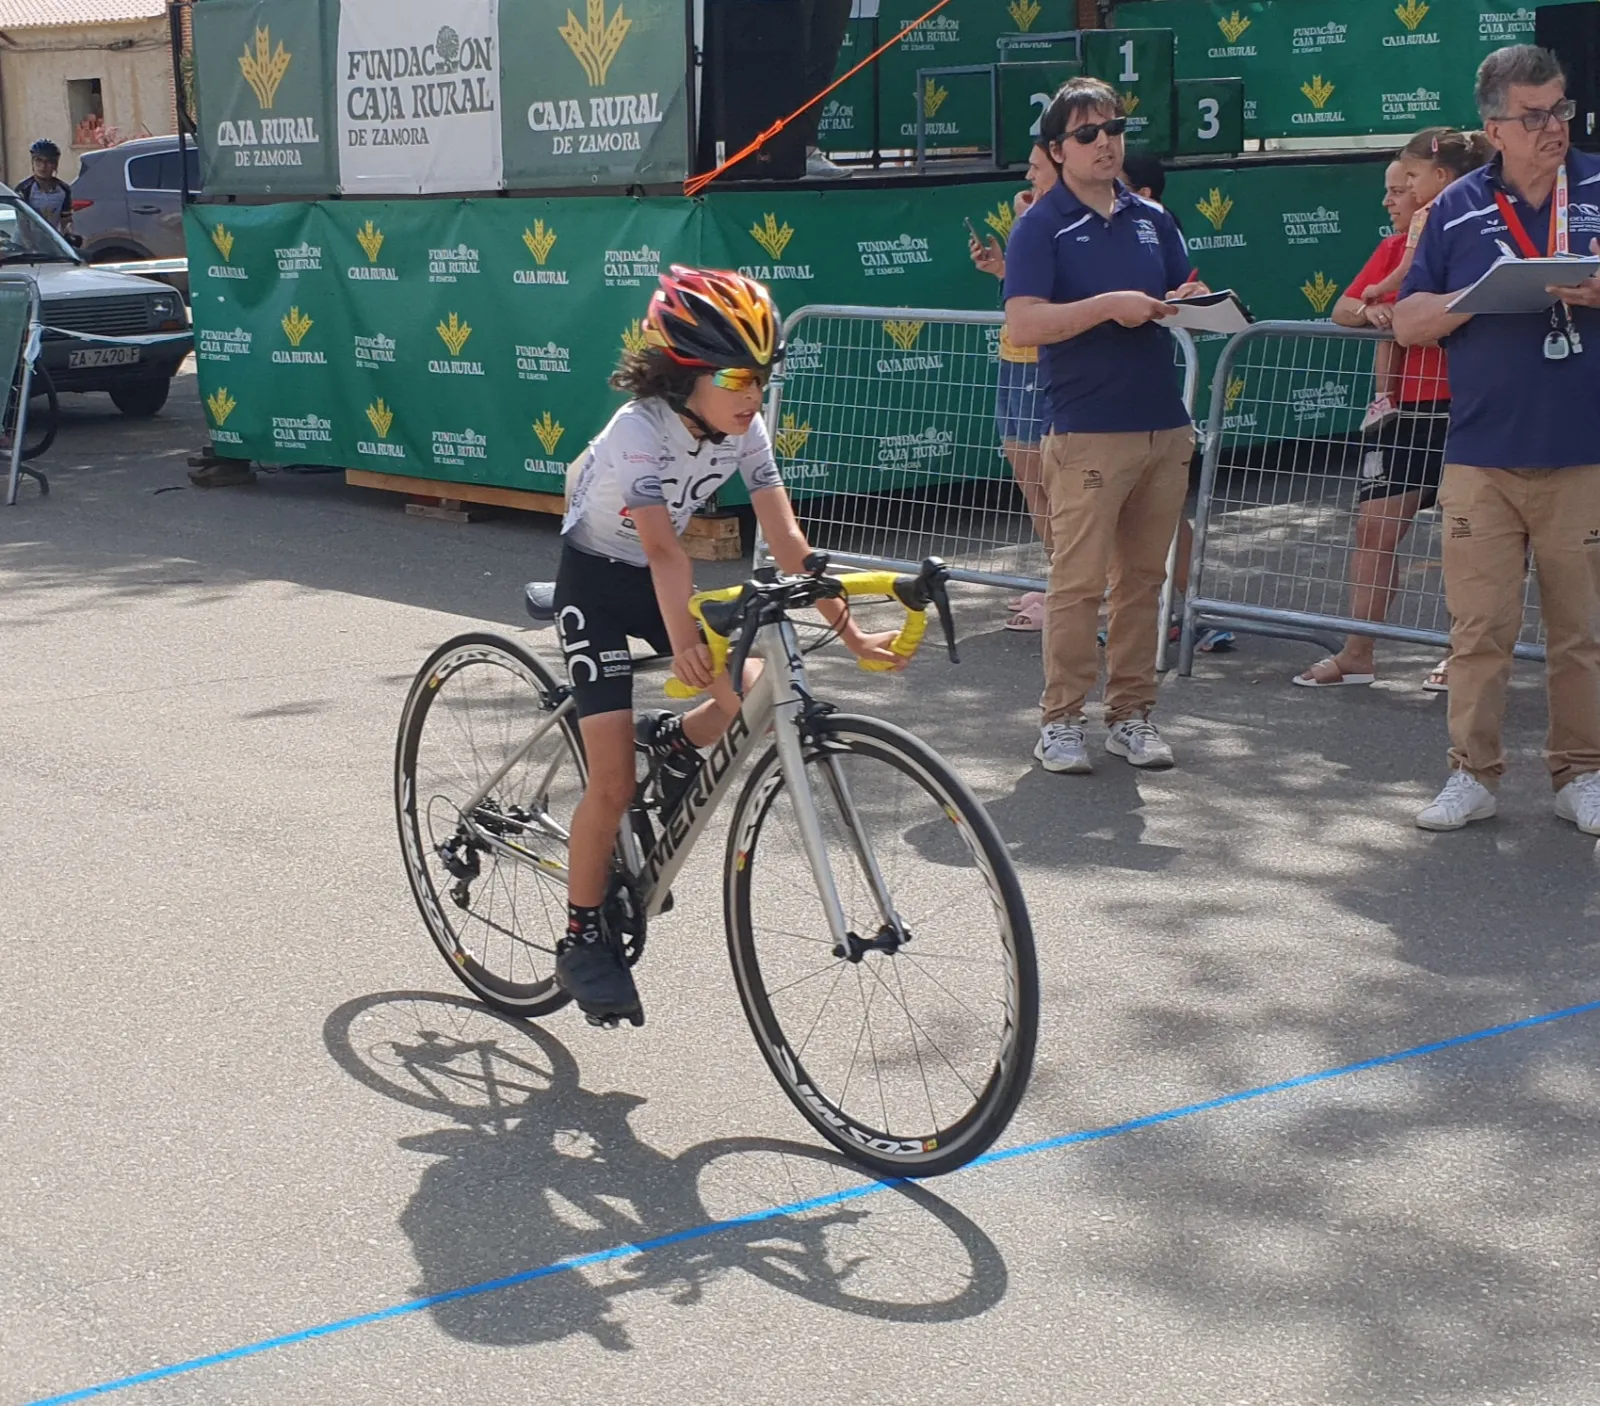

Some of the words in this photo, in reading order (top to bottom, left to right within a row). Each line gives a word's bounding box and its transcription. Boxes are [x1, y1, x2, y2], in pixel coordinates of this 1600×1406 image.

[1478, 22, 1504, 33] CAJA
[1507, 22, 1536, 32] RURA
[927, 32, 960, 42] RURAL
[1316, 34, 1346, 44] RURAL
[1382, 36, 1406, 47] CAJA
[1406, 32, 1440, 45] RURAL
[1228, 46, 1257, 57] RURAL
[1119, 40, 1139, 82] 1
[347, 86, 405, 123] CAJA
[411, 77, 494, 119] RURAL
[1407, 101, 1440, 112] RURAL
[527, 100, 585, 132] CAJA
[589, 92, 663, 128] RURAL
[1029, 92, 1051, 136] 2
[1197, 98, 1220, 139] 3
[1314, 111, 1345, 123] RURAL
[217, 120, 258, 147] CAJA
[260, 116, 320, 145] RURAL
[348, 129, 367, 146] DE
[372, 127, 430, 146] ZAMORA
[925, 122, 959, 135] RURAL
[552, 136, 573, 155] DE
[578, 132, 641, 153] ZAMORA
[234, 151, 251, 167] DE
[253, 149, 303, 167] ZAMORA
[1309, 221, 1341, 235] RURAL
[1188, 236, 1214, 250] CAJA
[1213, 234, 1247, 249] RURAL
[861, 253, 890, 268] CAJA
[891, 251, 933, 265] RURAL
[348, 267, 370, 280] CAJA
[370, 267, 399, 281] RURAL
[449, 262, 480, 274] RURAL
[604, 264, 629, 277] CAJA
[633, 264, 661, 277] RURAL
[737, 265, 772, 281] CAJA
[773, 264, 815, 280] RURAL
[513, 270, 536, 284] CAJA
[536, 270, 569, 285] RURAL
[223, 342, 251, 354] RURAL
[272, 351, 291, 363] CAJA
[291, 351, 328, 364] RURAL
[516, 358, 537, 371] CAJA
[539, 359, 571, 373] RURAL
[902, 355, 944, 371] RURAL
[428, 360, 450, 374] CAJA
[450, 361, 485, 376] RURAL
[273, 428, 296, 440] CAJA
[298, 429, 332, 442] RURAL
[357, 441, 377, 455] CAJA
[377, 442, 405, 458] RURAL
[432, 443, 455, 456] CAJA
[457, 445, 487, 459] RURAL
[912, 444, 952, 459] RURAL
[524, 458, 546, 473] CAJA
[546, 459, 570, 475] RUR
[782, 463, 829, 481] RURAL
[560, 605, 598, 687] CJC
[649, 708, 750, 883] MERIDA
